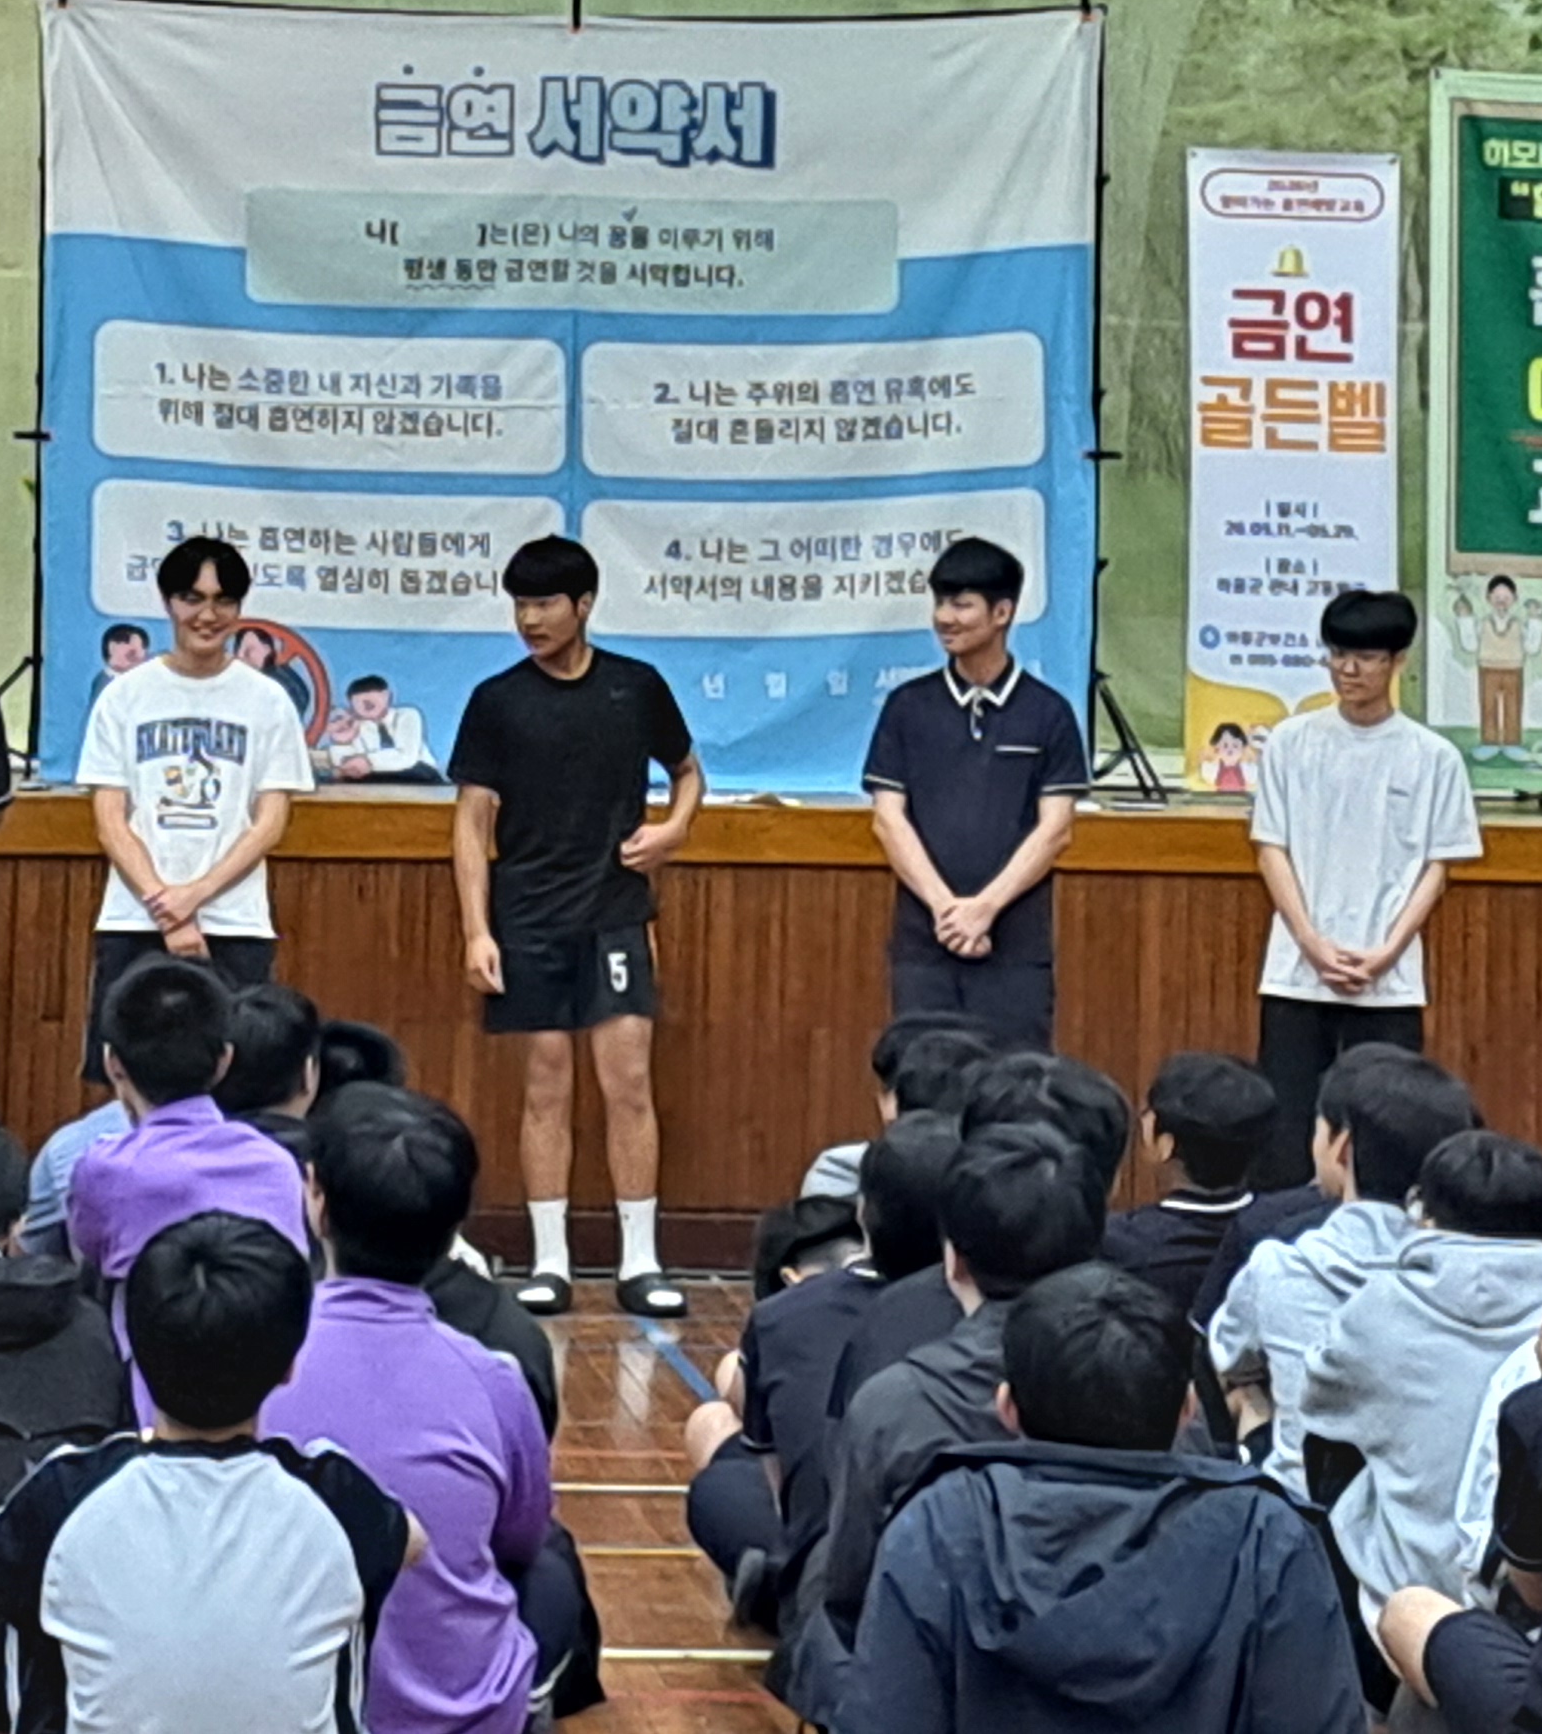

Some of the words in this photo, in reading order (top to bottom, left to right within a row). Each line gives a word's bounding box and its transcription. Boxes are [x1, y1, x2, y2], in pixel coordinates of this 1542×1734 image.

[375, 81, 515, 157] 금연
[527, 76, 777, 168] 서약서
[1227, 288, 1354, 363] 금연
[182, 363, 231, 392] 나는
[688, 380, 738, 407] 나는
[1197, 375, 1387, 454] 골든벨
[700, 537, 749, 564] 나는
[400, 569, 500, 597] 돕겠습니
[833, 568, 931, 598] 지키겠습
[607, 952, 628, 993] 5
